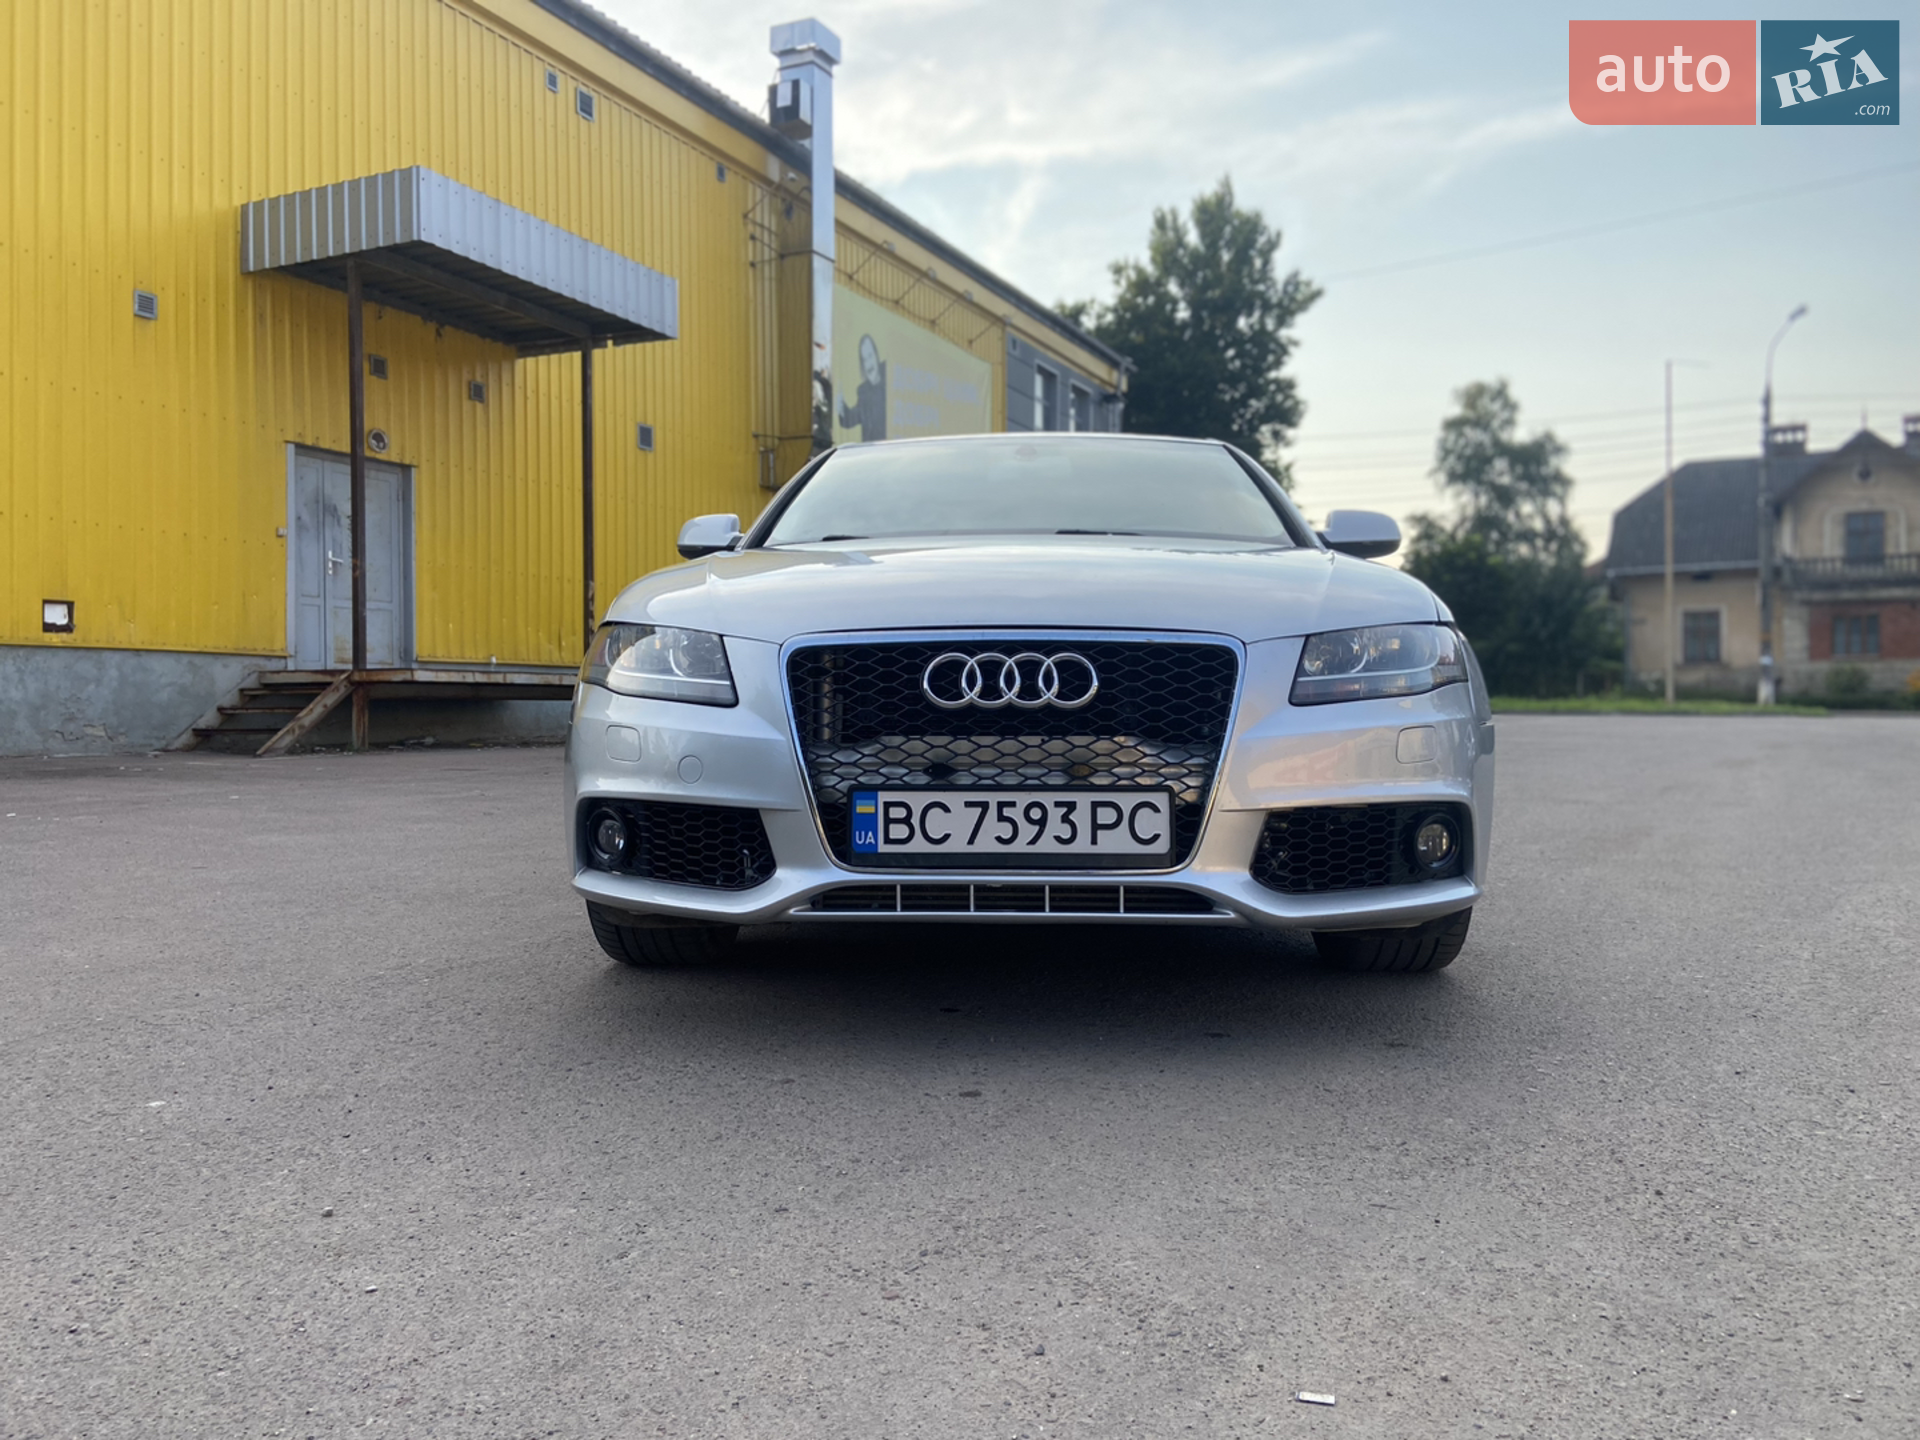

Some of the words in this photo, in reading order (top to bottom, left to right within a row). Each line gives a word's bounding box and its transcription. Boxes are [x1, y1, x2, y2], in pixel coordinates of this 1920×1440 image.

[855, 831, 876, 845] UA
[882, 800, 952, 846] BC
[963, 800, 1078, 846] 7593
[1089, 800, 1162, 846] PC
